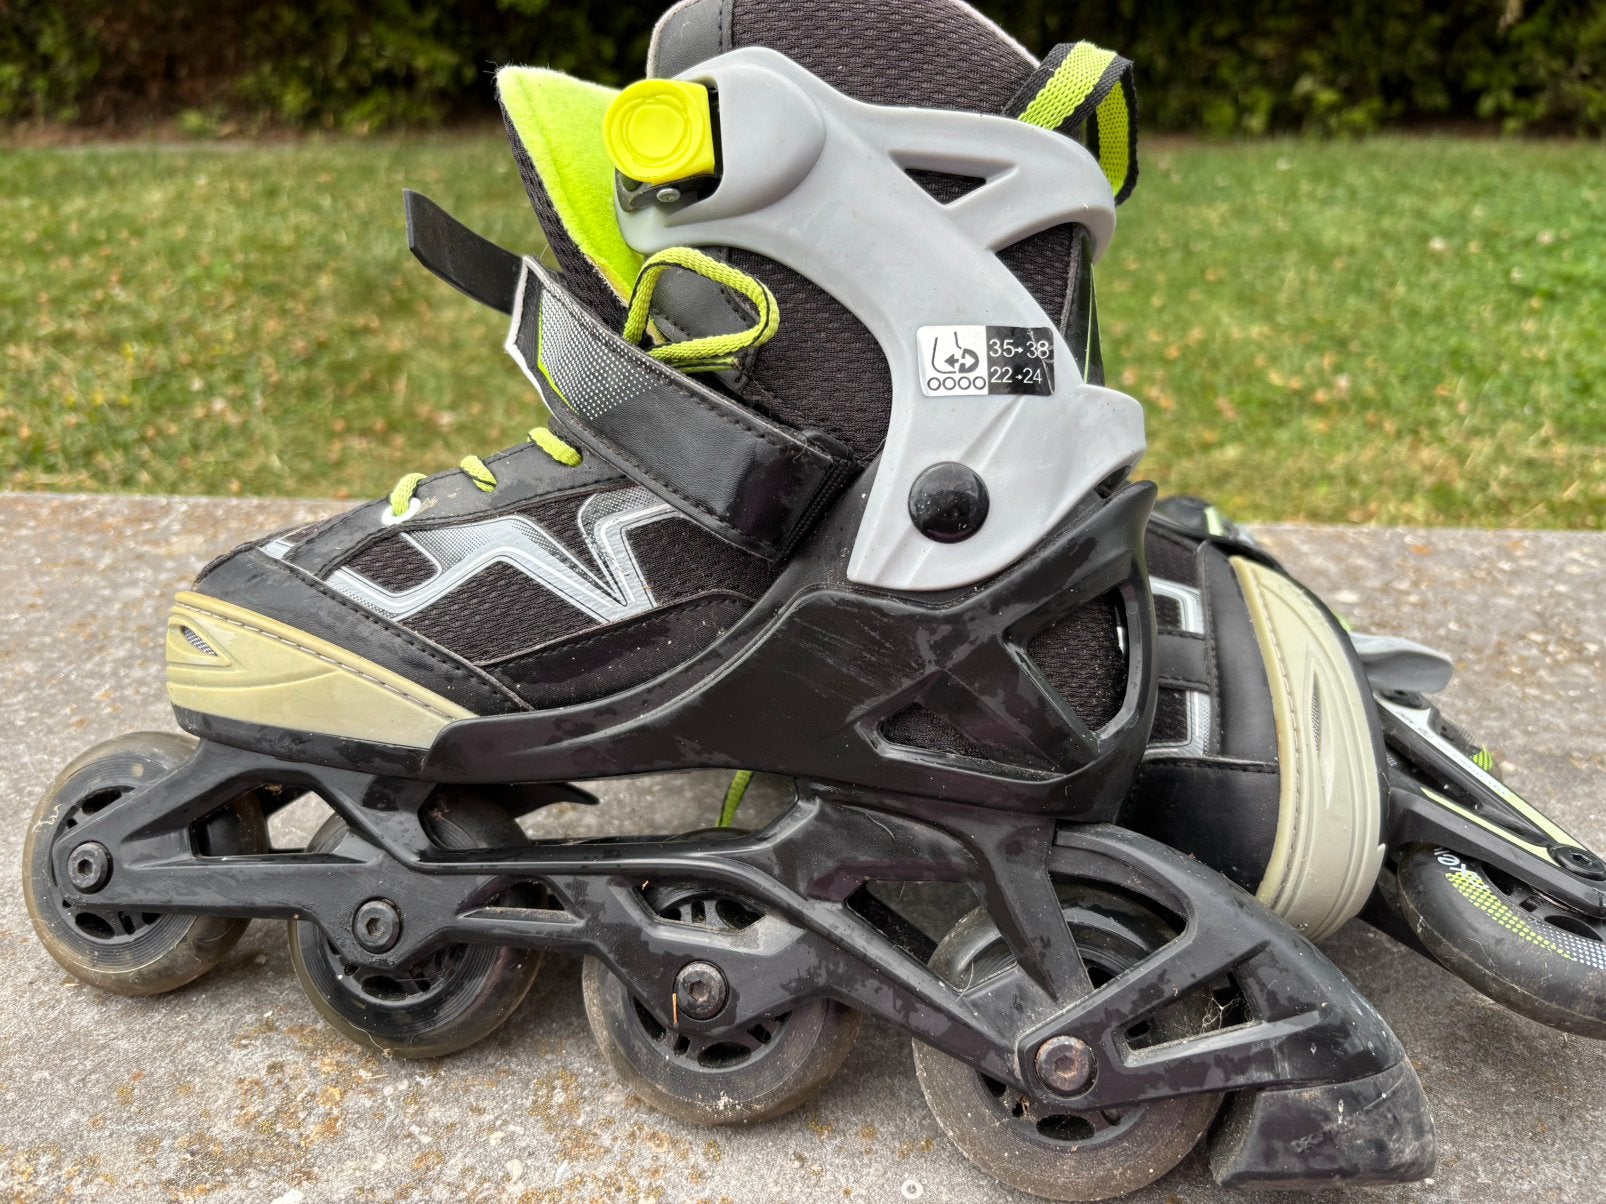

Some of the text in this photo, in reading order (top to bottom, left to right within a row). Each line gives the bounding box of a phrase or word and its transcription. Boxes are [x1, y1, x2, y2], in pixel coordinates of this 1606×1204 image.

[989, 339, 1049, 359] 35 38
[990, 366, 1043, 384] 22 24
